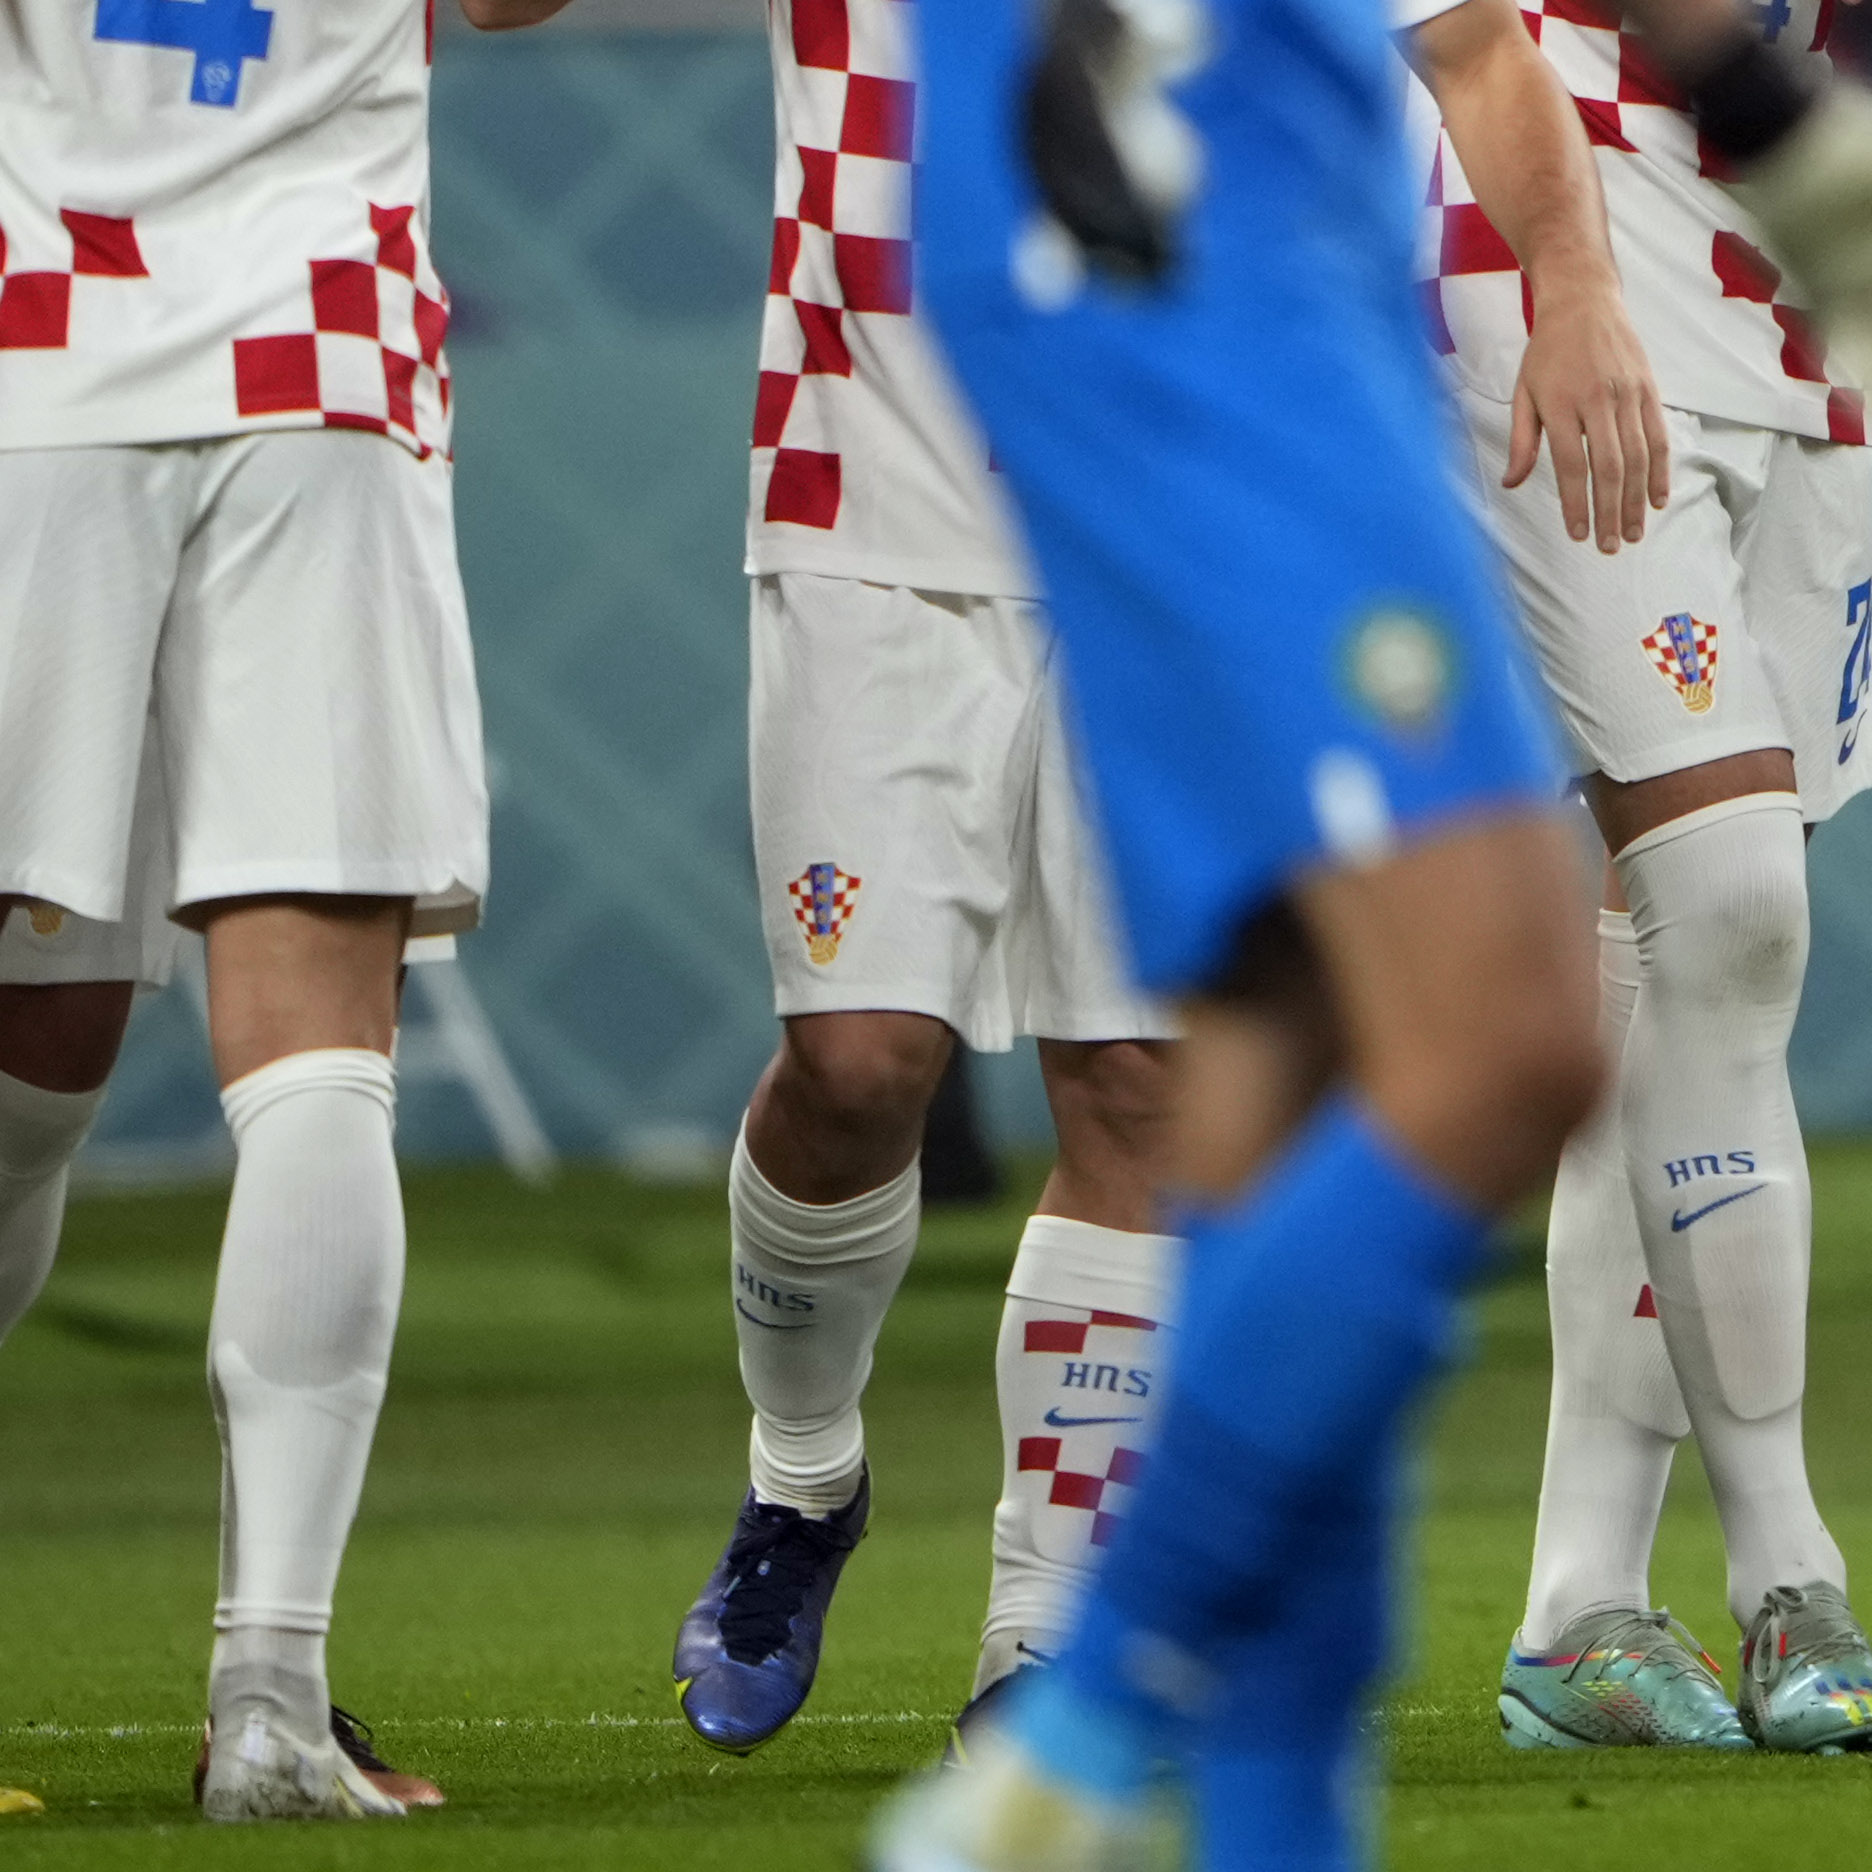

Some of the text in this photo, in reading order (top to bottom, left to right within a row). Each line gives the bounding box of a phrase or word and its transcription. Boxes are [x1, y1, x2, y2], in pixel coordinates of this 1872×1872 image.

[1662, 1151, 1755, 1188] HNS
[737, 1264, 816, 1313] HNS
[1060, 1362, 1153, 1398] HNS
